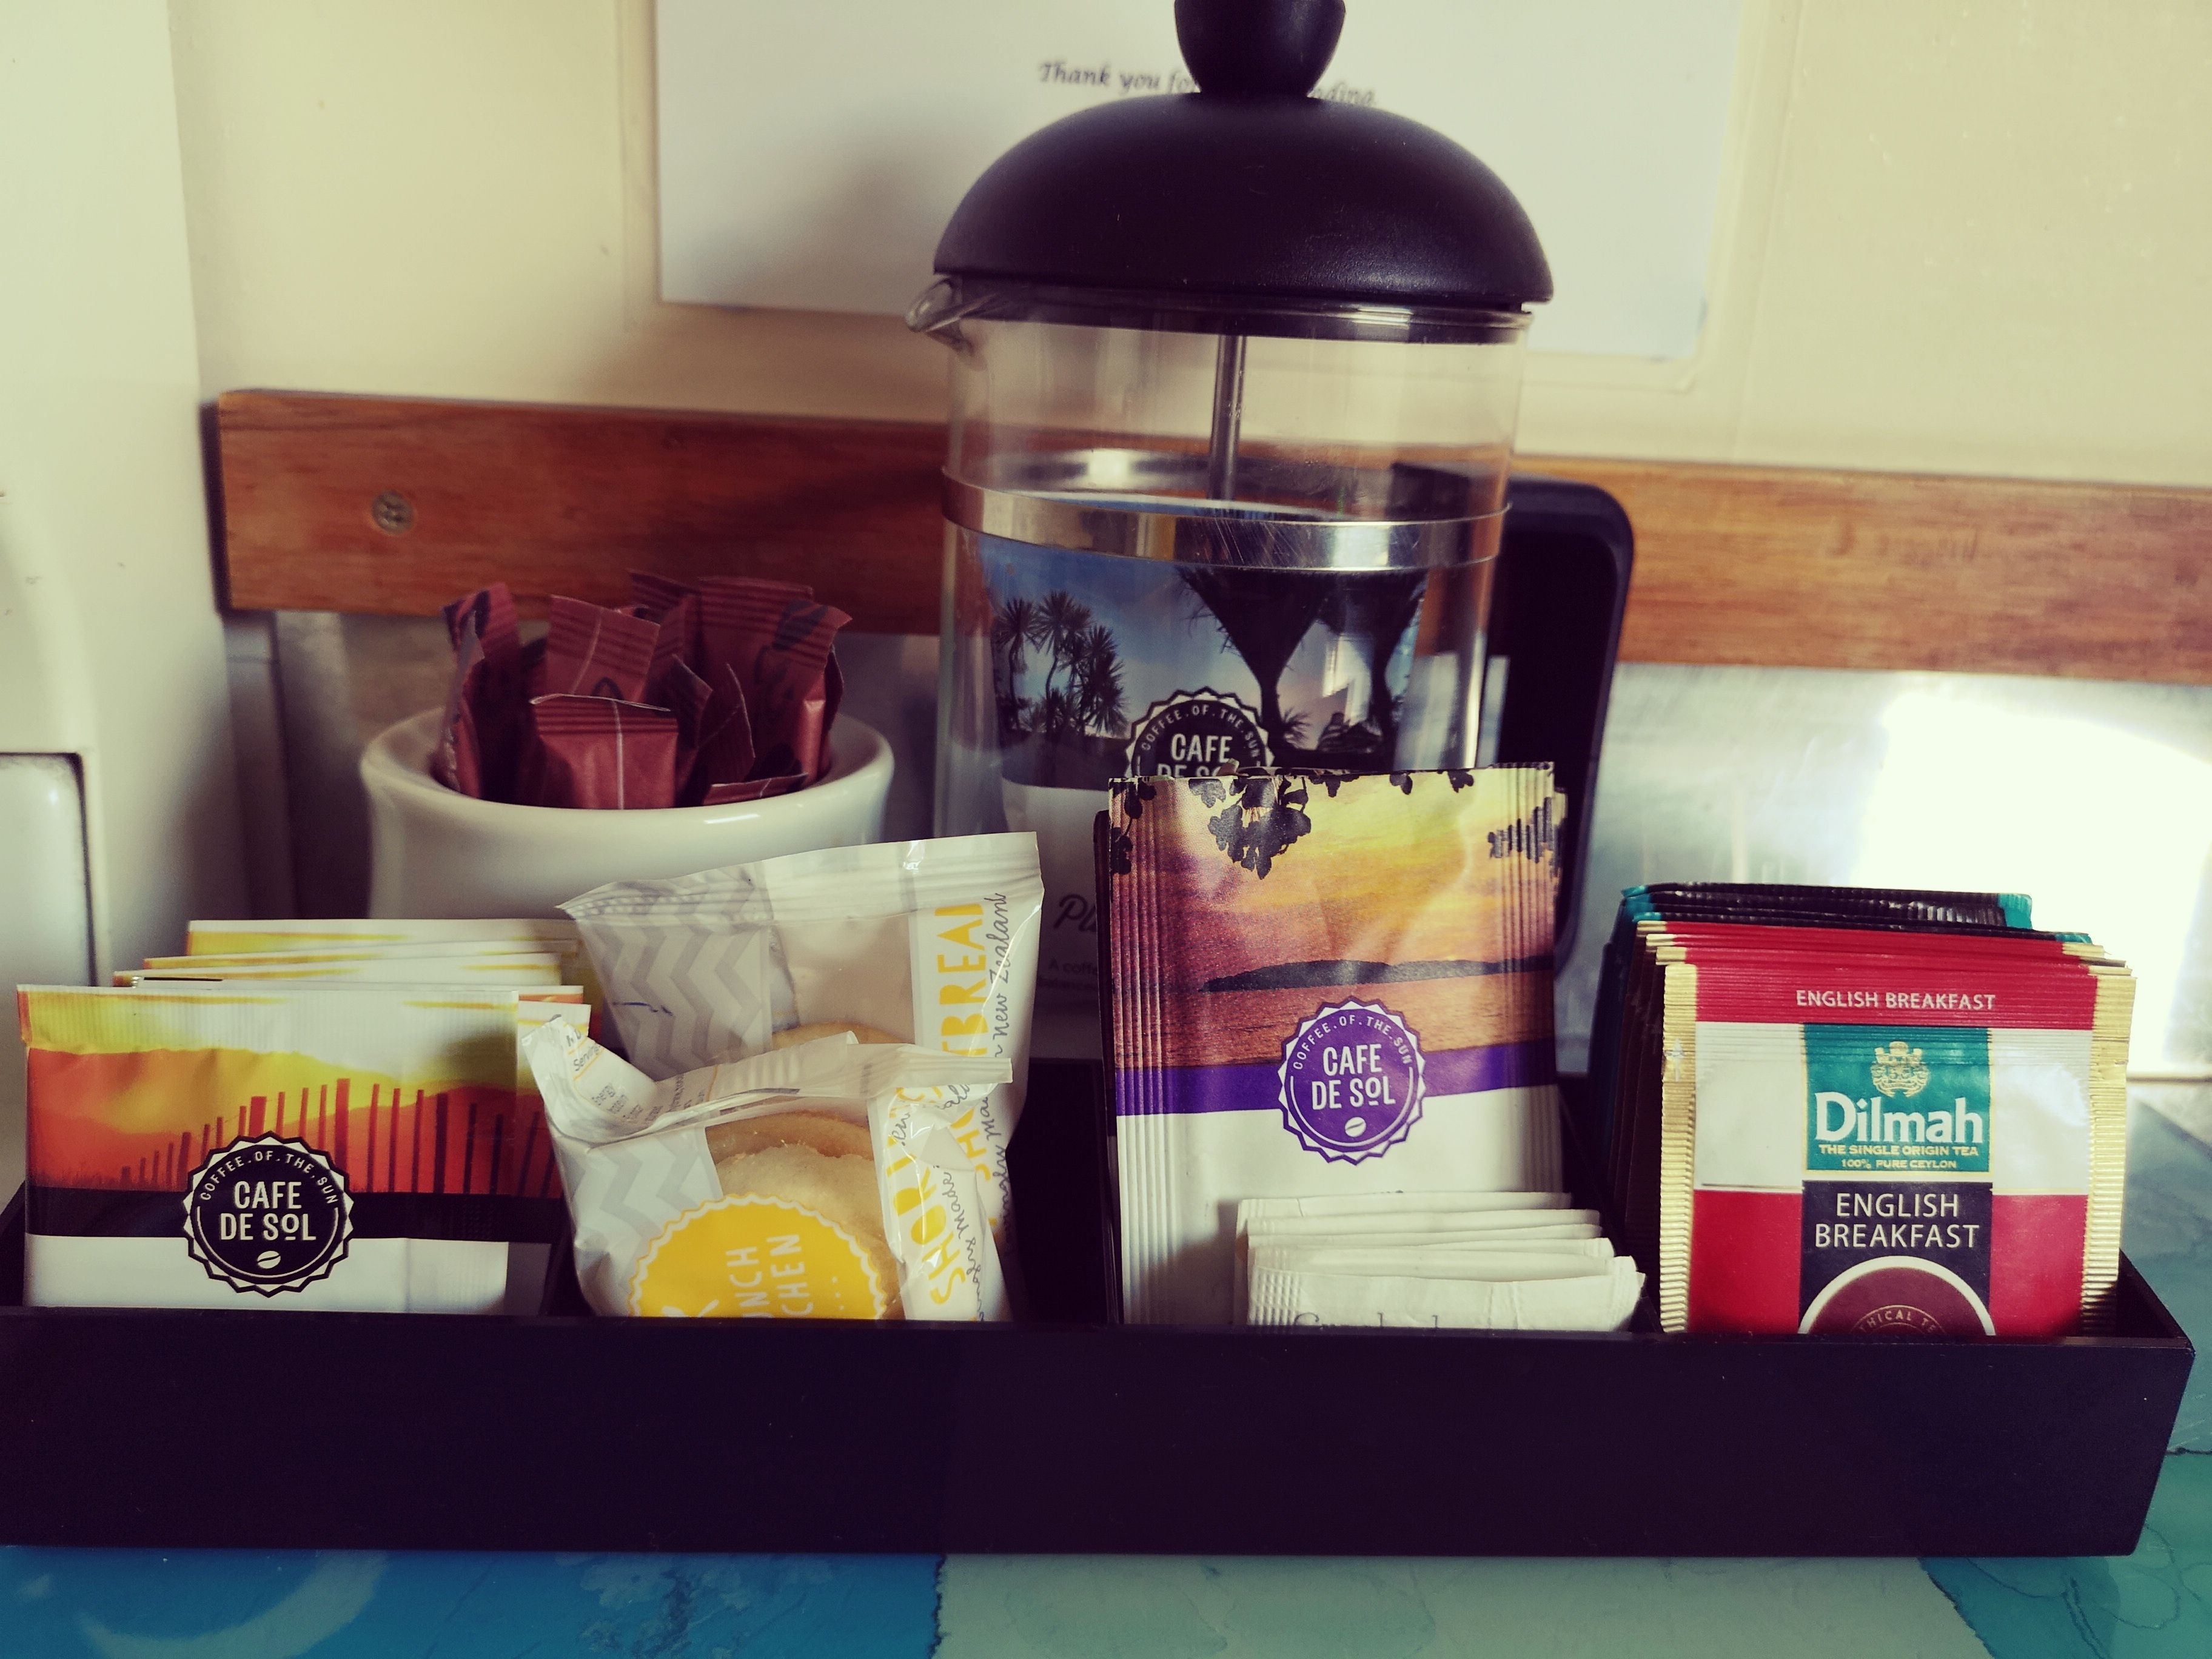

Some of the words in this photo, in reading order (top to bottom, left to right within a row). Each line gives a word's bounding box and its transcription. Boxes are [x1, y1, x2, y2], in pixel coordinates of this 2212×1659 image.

[1040, 60, 1111, 86] Thank
[1119, 73, 1161, 93] you
[1167, 69, 1200, 93] fo
[1141, 709, 1182, 751] COFFEE
[1191, 704, 1210, 716] OF
[1220, 708, 1244, 728] THE
[1244, 731, 1261, 758] SUN
[1171, 733, 1233, 763] CAFE
[1796, 990, 1879, 1008] ENGLISH
[1885, 992, 1996, 1010] BREAKFAST
[1293, 1022, 1332, 1070] COFFEE
[1339, 1014, 1356, 1026] OF
[1366, 1016, 1392, 1035] THE
[1393, 1036, 1413, 1064] SUN
[1322, 1043, 1383, 1076] CAFE
[1311, 1079, 1342, 1110] DE
[1814, 1091, 1983, 1144] Dilmah
[1818, 1144, 1846, 1155] THE
[1849, 1144, 1900, 1155] SINGLE
[1902, 1145, 1949, 1156] ORIGIN
[1952, 1146, 1979, 1156] TEA
[1842, 1158, 1872, 1170] 100%
[1875, 1159, 1908, 1168] PURE
[1909, 1159, 1957, 1169] CEYLON
[200, 1156, 245, 1201] COFFEE
[255, 1150, 273, 1161] OF
[286, 1153, 314, 1173] THE
[316, 1175, 338, 1204] SUN
[234, 1181, 303, 1209] CAFE
[1836, 1192, 1959, 1218] ENGLISH
[220, 1213, 254, 1241] DE
[1815, 1223, 1980, 1249] BREAKFAST
[766, 1234, 814, 1316] CHEN
[1858, 1309, 1912, 1333] THICAL
